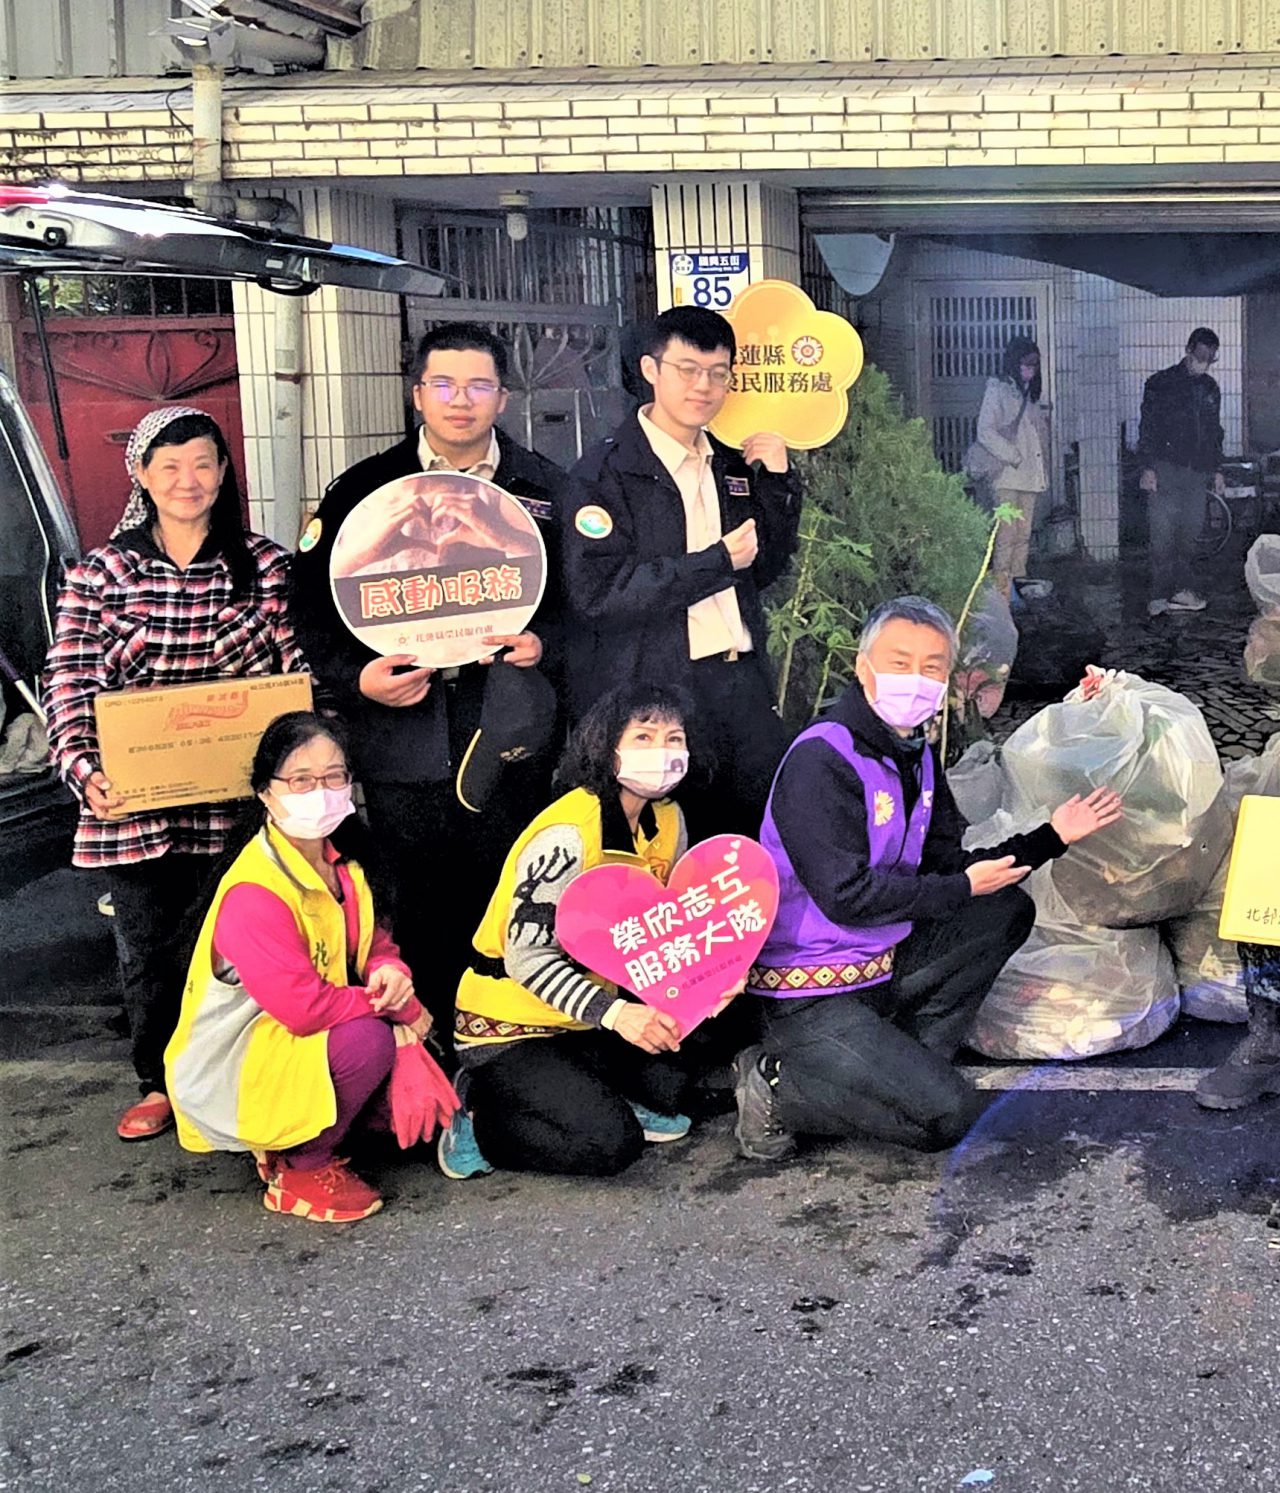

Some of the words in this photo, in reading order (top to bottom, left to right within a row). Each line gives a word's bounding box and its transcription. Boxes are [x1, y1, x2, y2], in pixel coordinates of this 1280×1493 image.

[694, 276, 732, 306] 85
[733, 344, 785, 366] 蓮縣
[360, 564, 522, 618] 感動服務
[625, 899, 767, 991] 服務大隊
